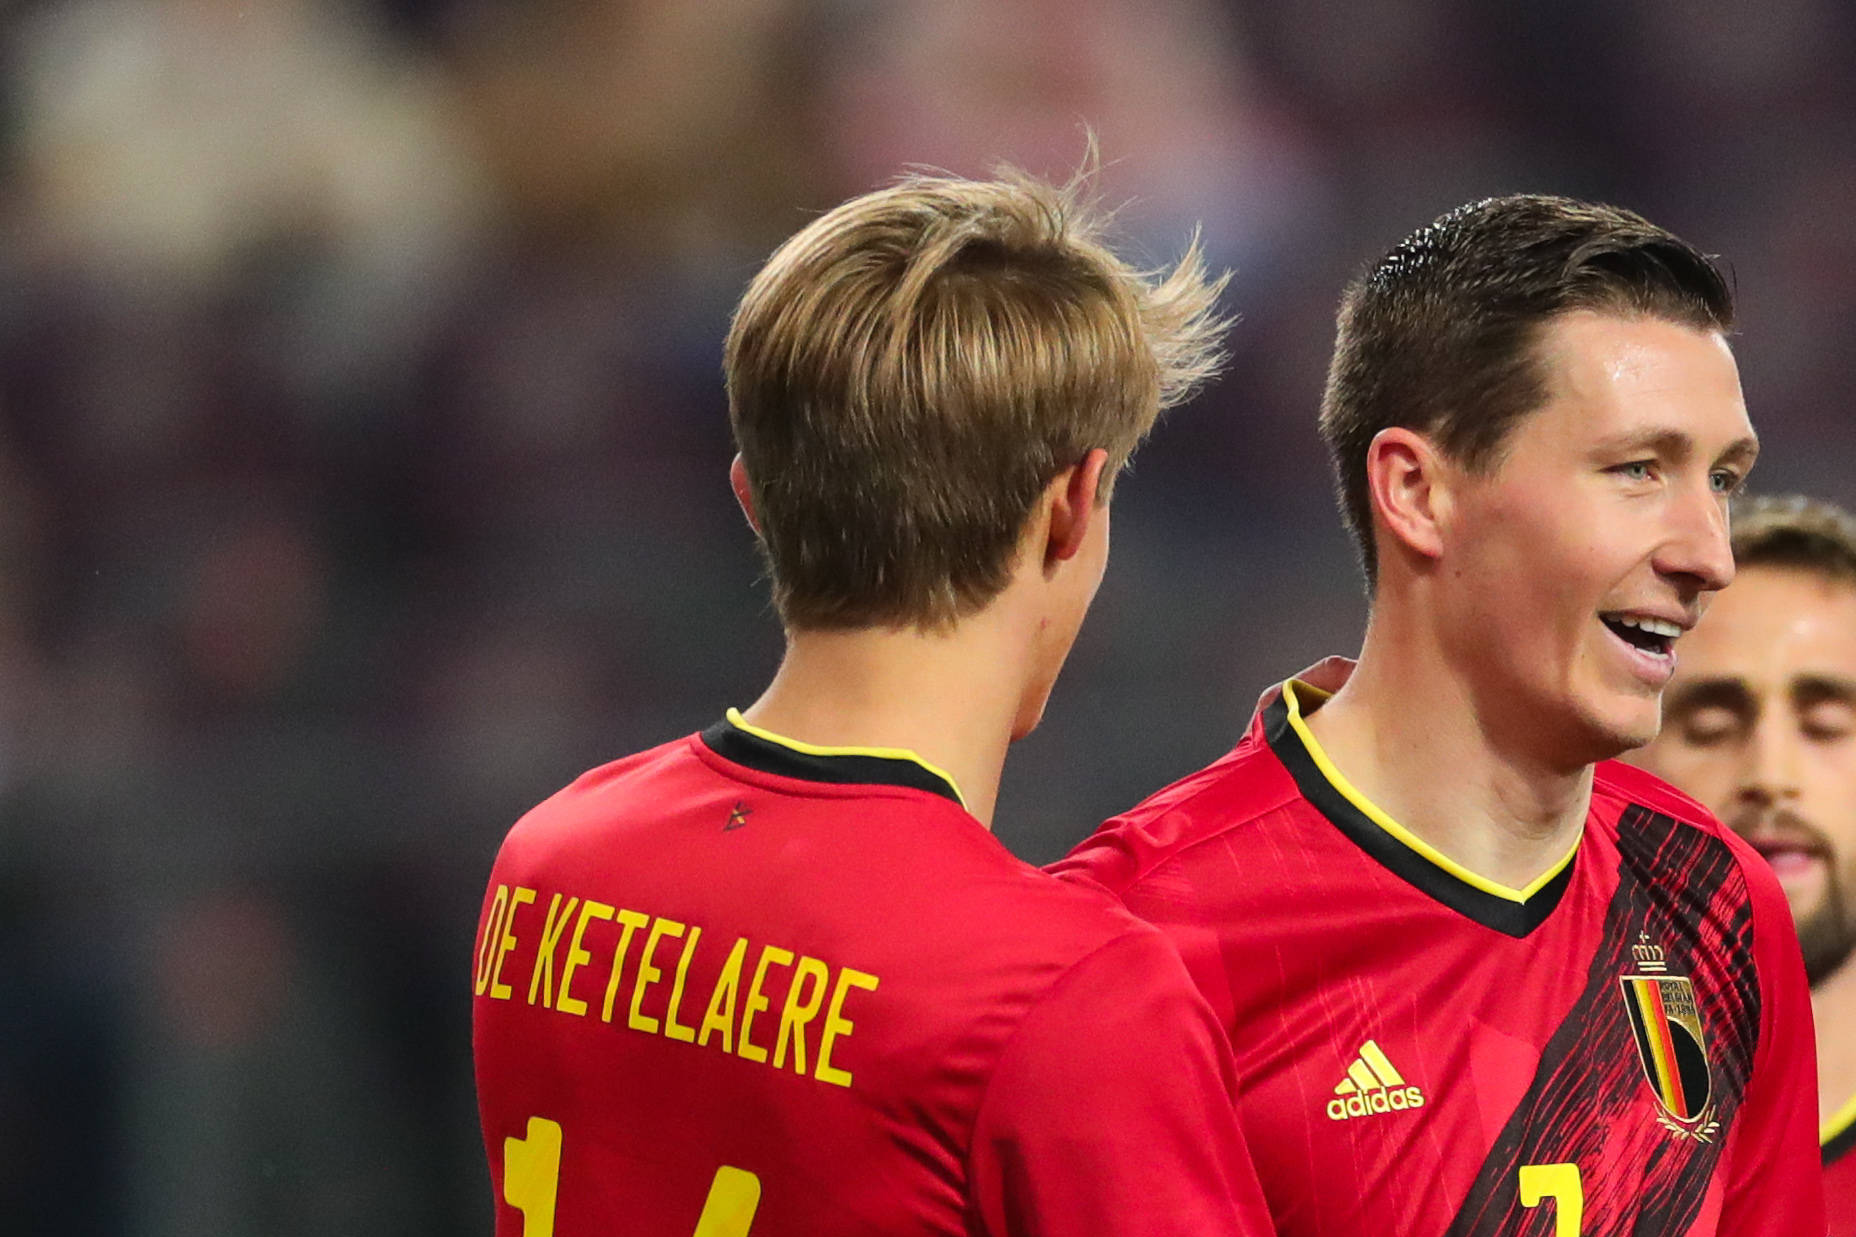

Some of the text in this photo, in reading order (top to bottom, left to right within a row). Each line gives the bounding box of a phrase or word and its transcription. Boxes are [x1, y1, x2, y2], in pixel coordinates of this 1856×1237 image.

[475, 884, 880, 1088] DE KETELAERE
[1326, 1085, 1424, 1120] adidas
